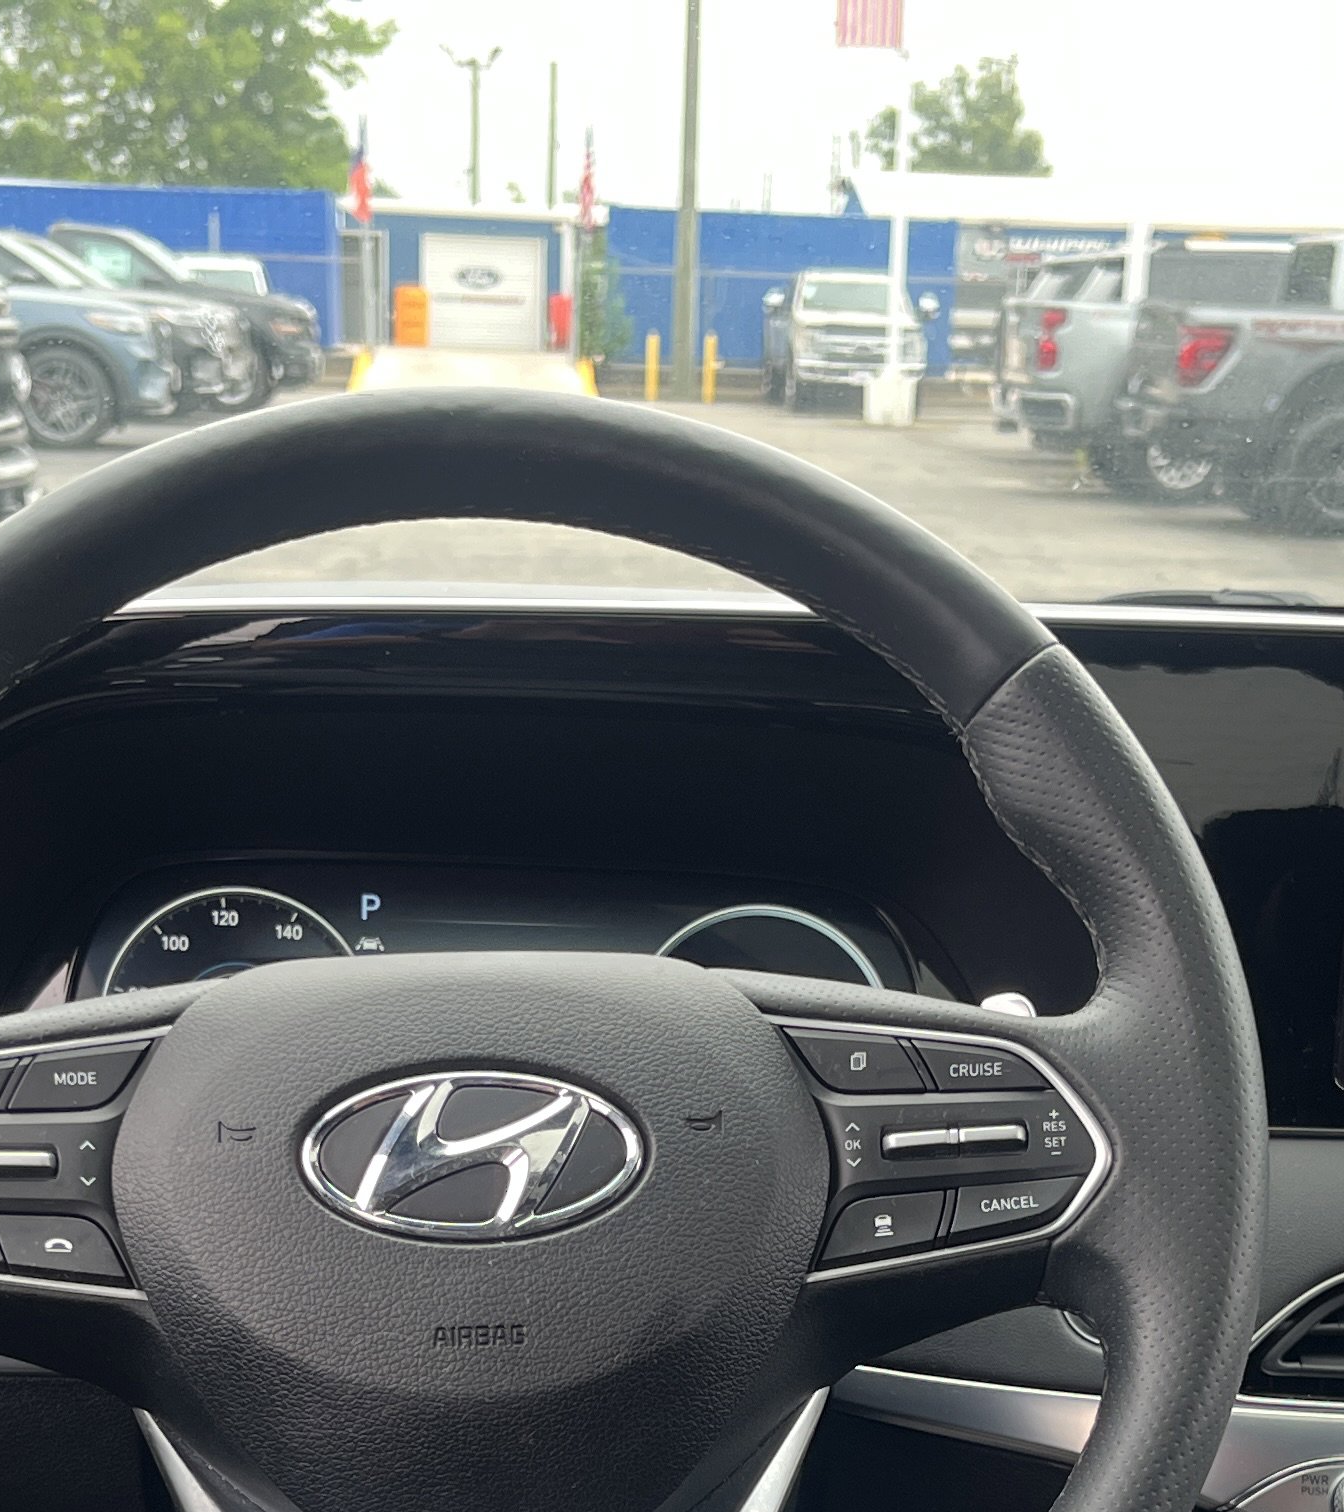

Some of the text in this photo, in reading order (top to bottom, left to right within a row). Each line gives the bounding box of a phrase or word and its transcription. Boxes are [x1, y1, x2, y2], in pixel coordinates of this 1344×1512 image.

[360, 893, 381, 921] P
[211, 910, 239, 927] 120
[275, 924, 304, 941] 140
[161, 934, 191, 952] 100
[948, 1061, 1004, 1078] CRUISE
[53, 1071, 98, 1086] MODE
[1042, 1119, 1067, 1132] RES
[844, 1138, 860, 1151] OK
[1043, 1135, 1067, 1149] SET
[979, 1195, 1040, 1212] CANCEL
[432, 1324, 526, 1348] AIRBAG
[1301, 1474, 1329, 1486] PWR
[1301, 1485, 1329, 1497] PUSH
